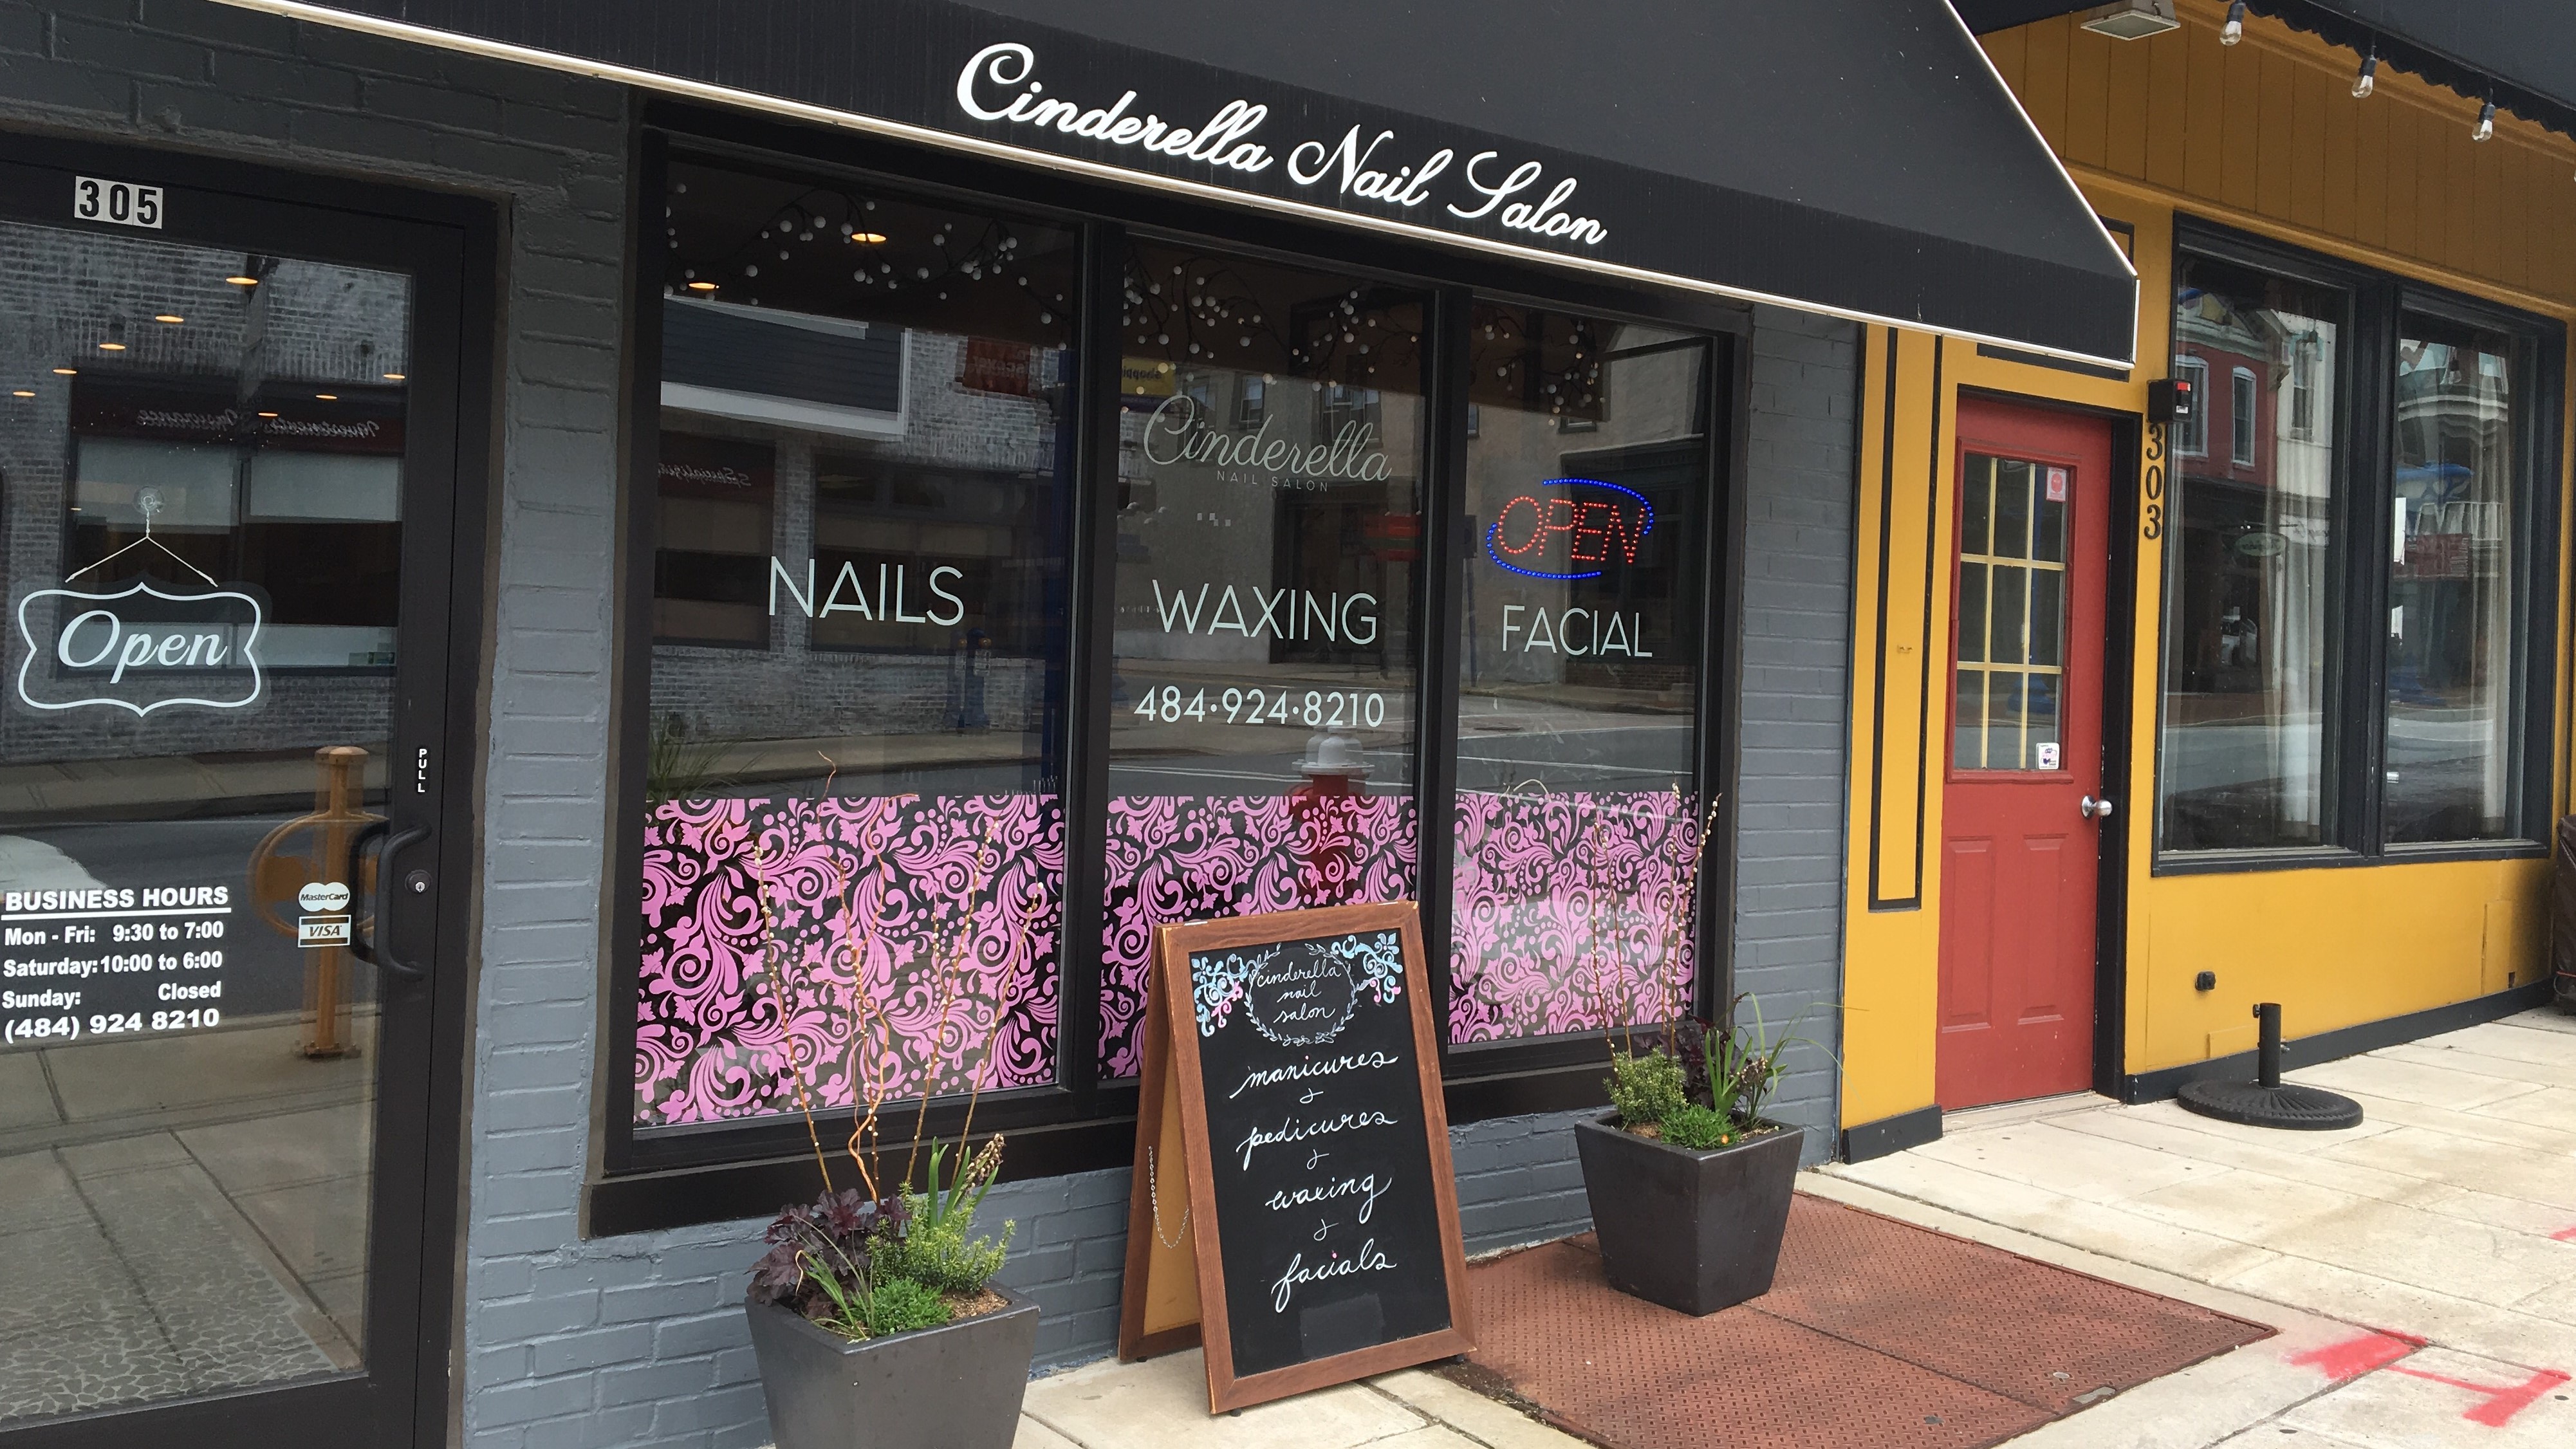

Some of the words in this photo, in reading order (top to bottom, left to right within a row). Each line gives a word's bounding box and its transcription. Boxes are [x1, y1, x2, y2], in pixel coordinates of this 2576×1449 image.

[957, 42, 1274, 172] Cinderella
[1288, 124, 1454, 207] Nail
[1447, 151, 1608, 245] Salon
[79, 180, 158, 225] 305
[1144, 394, 1393, 483] Cinderella
[1217, 470, 1258, 485] NAIL
[1271, 475, 1329, 493] SALON
[2144, 423, 2164, 540] 303
[1497, 495, 1645, 564] OPEN
[769, 556, 964, 626] NAILS
[1152, 579, 1377, 645] WAXING
[58, 610, 228, 684] Open
[1503, 605, 1653, 657] FACIAL
[418, 748, 427, 793] PULL
[5, 888, 134, 911] BUSINESS
[143, 886, 228, 907] HOURS
[5, 928, 46, 946] Mon
[64, 926, 95, 943] Fri:
[112, 924, 153, 942] 9:30
[158, 923, 178, 941] to
[184, 921, 224, 939] 7:00
[309, 925, 340, 937] VISA
[3, 959, 98, 978] Saturday:
[100, 954, 153, 973] 10:00
[158, 954, 178, 970] to
[183, 950, 223, 969] 6:00
[1257, 958, 1341, 987] cinderella
[2, 990, 81, 1010] Sunday:
[158, 981, 221, 1001] Closed
[1273, 1002, 1336, 1023] salon
[1277, 980, 1322, 1003] nail
[5, 1017, 80, 1044] (484)
[89, 1011, 143, 1034] 924
[151, 1008, 219, 1030] 8210
[1229, 1051, 1399, 1099] manicures
[1236, 1111, 1398, 1171] pedicures
[1265, 1173, 1392, 1224] waxing
[1270, 1238, 1397, 1313] facials
